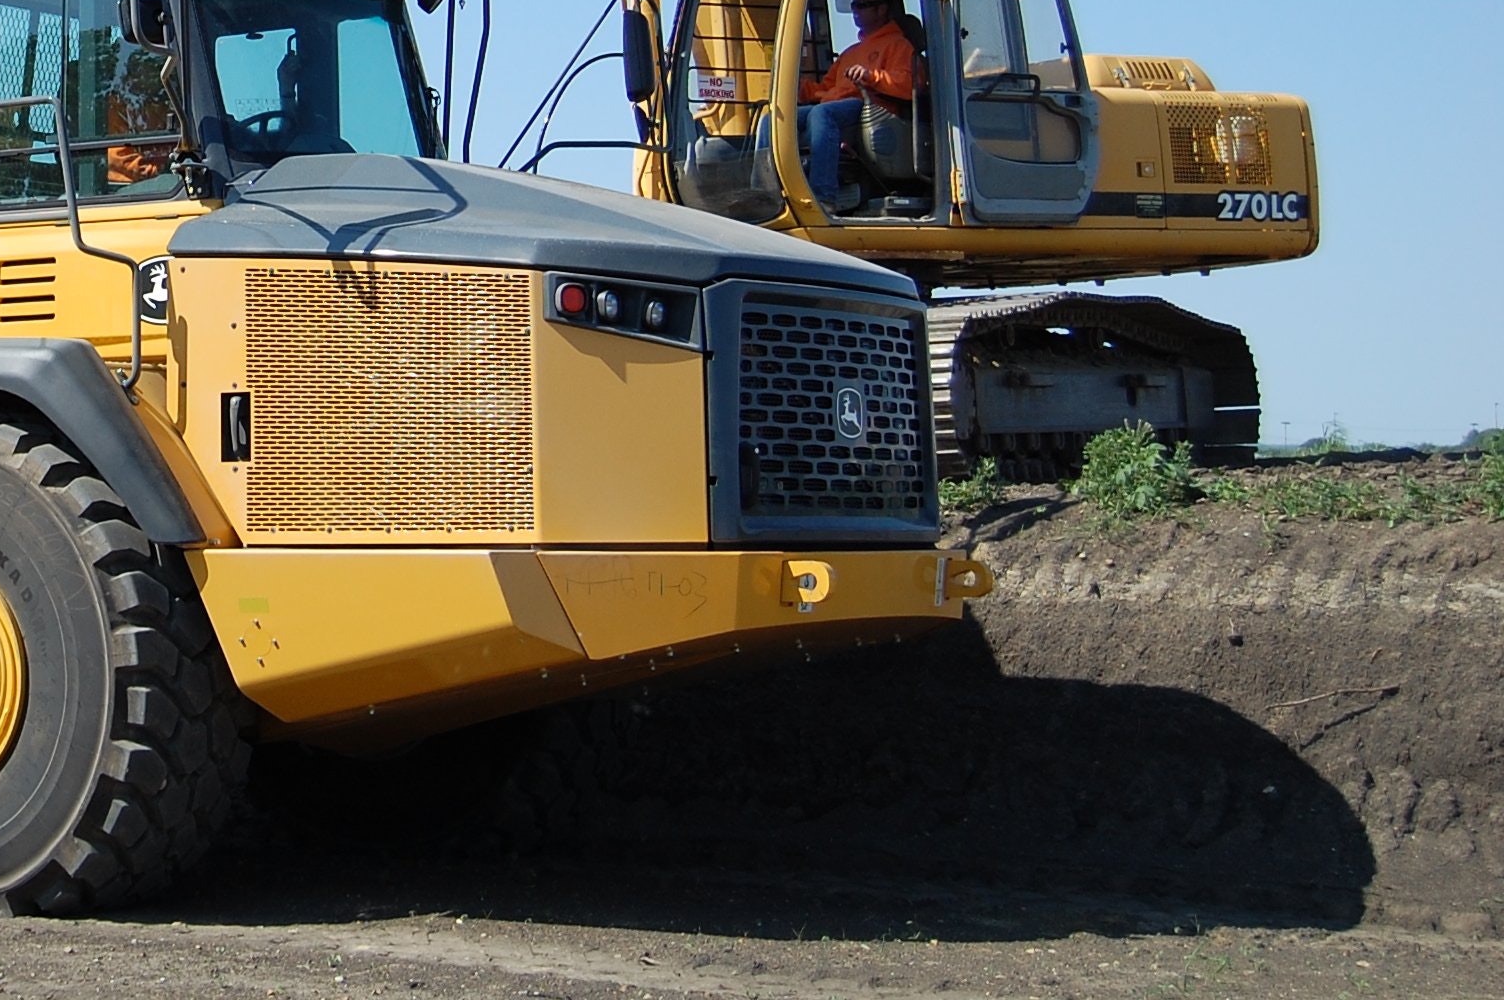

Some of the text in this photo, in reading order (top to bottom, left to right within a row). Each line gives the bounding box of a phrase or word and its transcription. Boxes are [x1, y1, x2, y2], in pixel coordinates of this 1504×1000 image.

[709, 77, 723, 87] NO
[699, 88, 735, 99] SMOKING
[1216, 192, 1299, 221] 270LC
